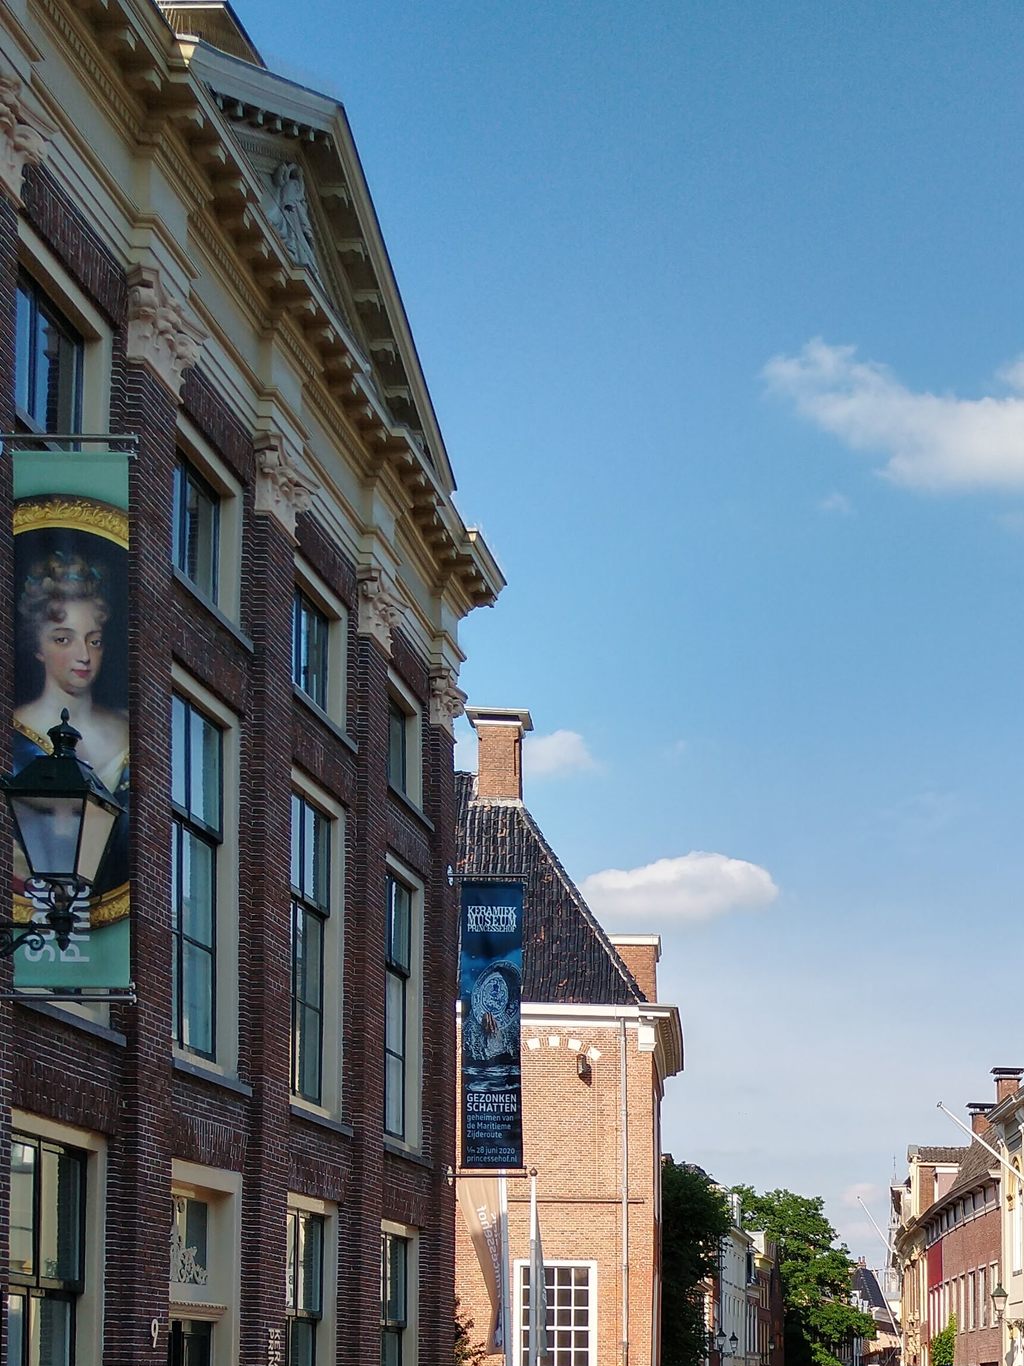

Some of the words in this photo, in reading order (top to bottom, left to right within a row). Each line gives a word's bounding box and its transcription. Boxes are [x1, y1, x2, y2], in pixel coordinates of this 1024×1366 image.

[467, 905, 517, 916] KERAMIEK
[467, 914, 517, 927] MUSEUM
[466, 1093, 517, 1103] GEZONKEN
[466, 1102, 517, 1113] SCHATTEN
[466, 1113, 501, 1123] geheimen
[466, 1122, 476, 1130] de
[476, 1122, 511, 1130] Maritieme
[466, 1130, 503, 1140] Zijderoute
[485, 1146, 498, 1156] juni
[498, 1147, 516, 1155] 2020
[466, 1155, 518, 1164] princessehof.nl
[151, 1319, 159, 1348] 9
